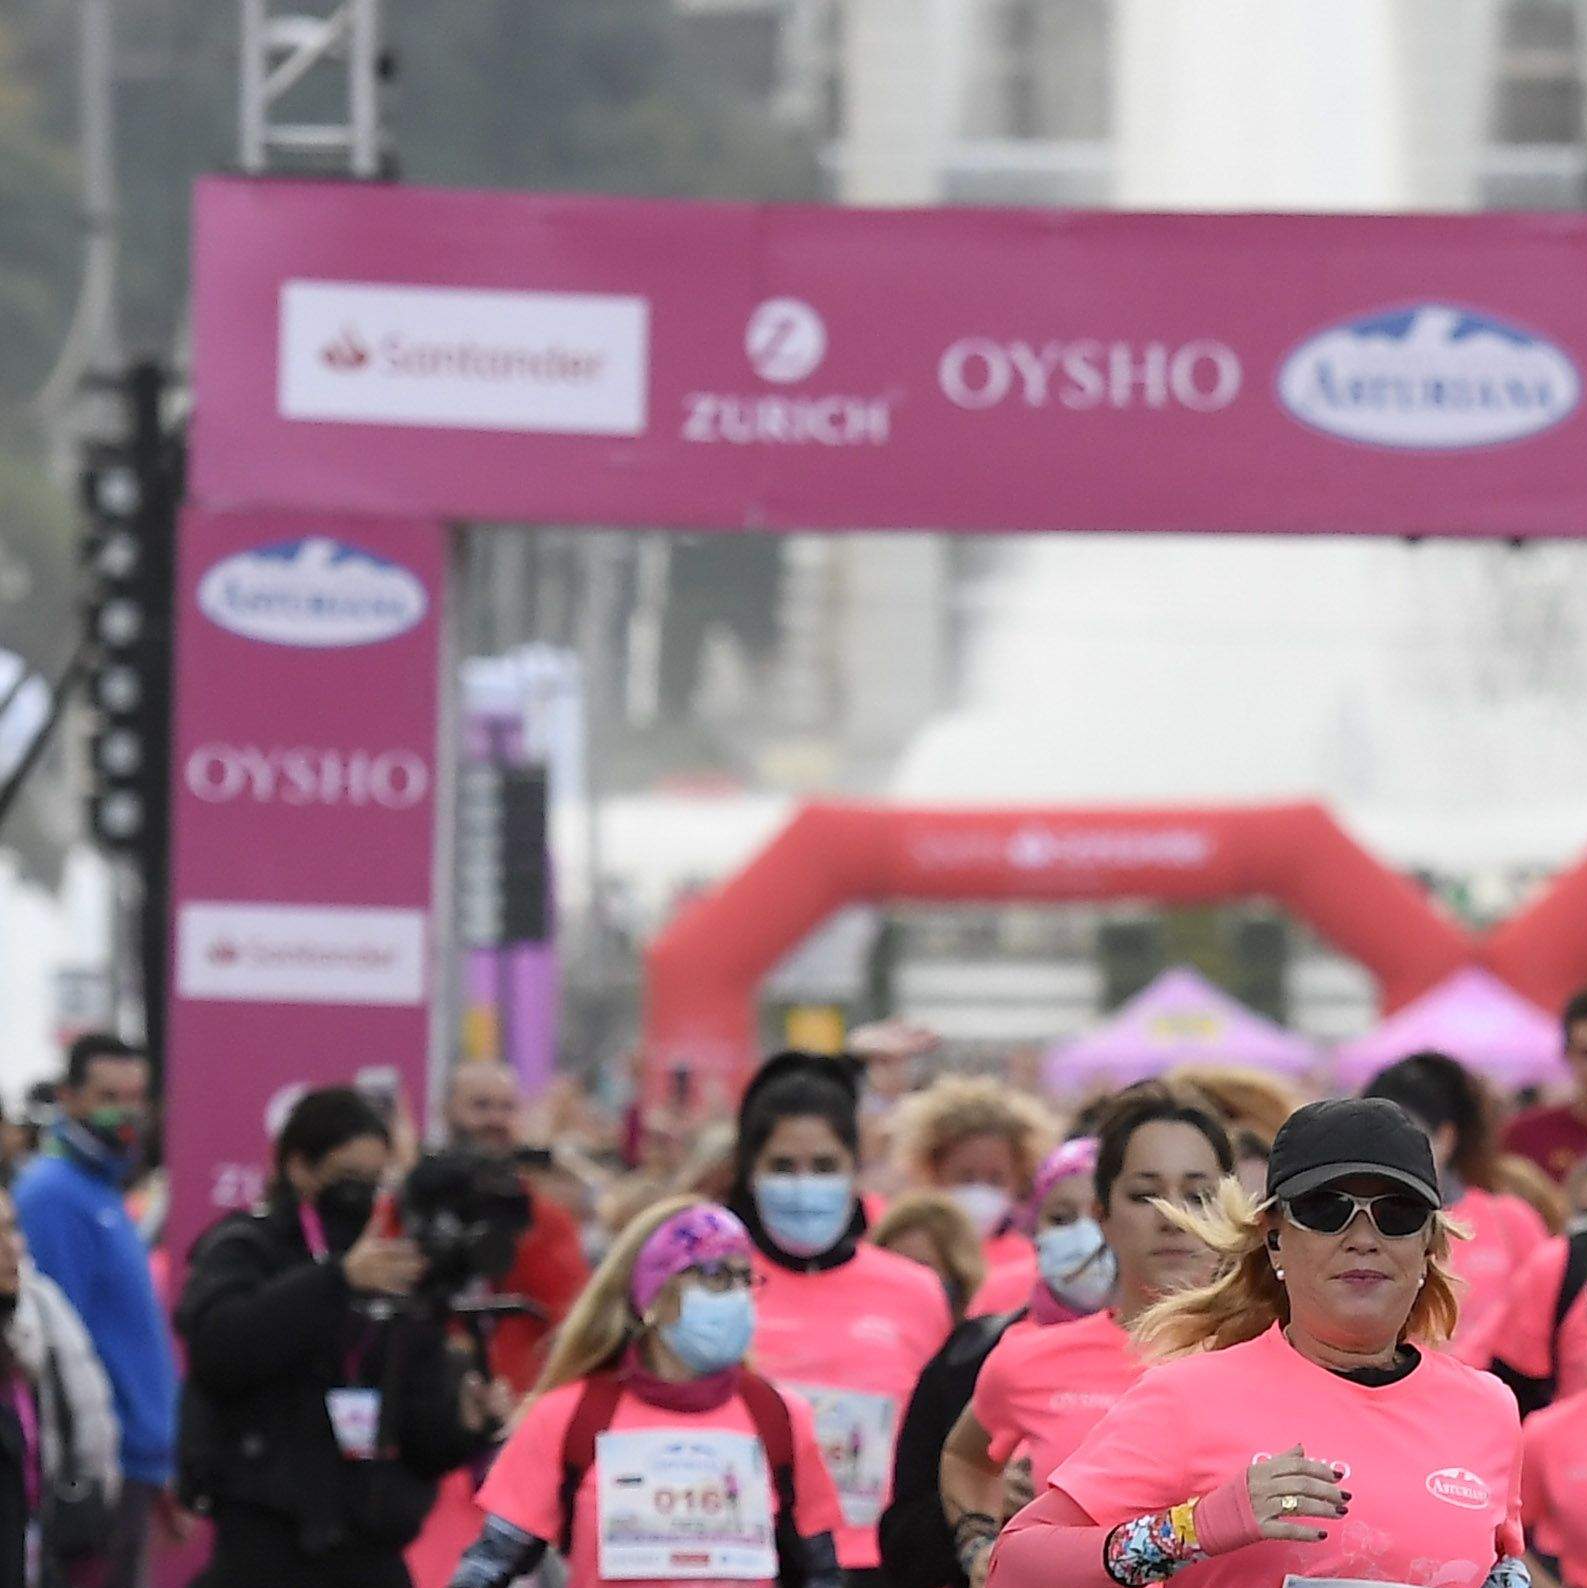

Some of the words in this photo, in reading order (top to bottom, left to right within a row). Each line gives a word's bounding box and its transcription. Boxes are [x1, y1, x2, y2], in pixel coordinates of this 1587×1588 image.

[379, 335, 606, 385] Santander
[937, 337, 1243, 410] OYSHO
[1306, 359, 1554, 408] ASTURIANA
[682, 391, 893, 446] ZURICH
[185, 740, 430, 808] OYSHO
